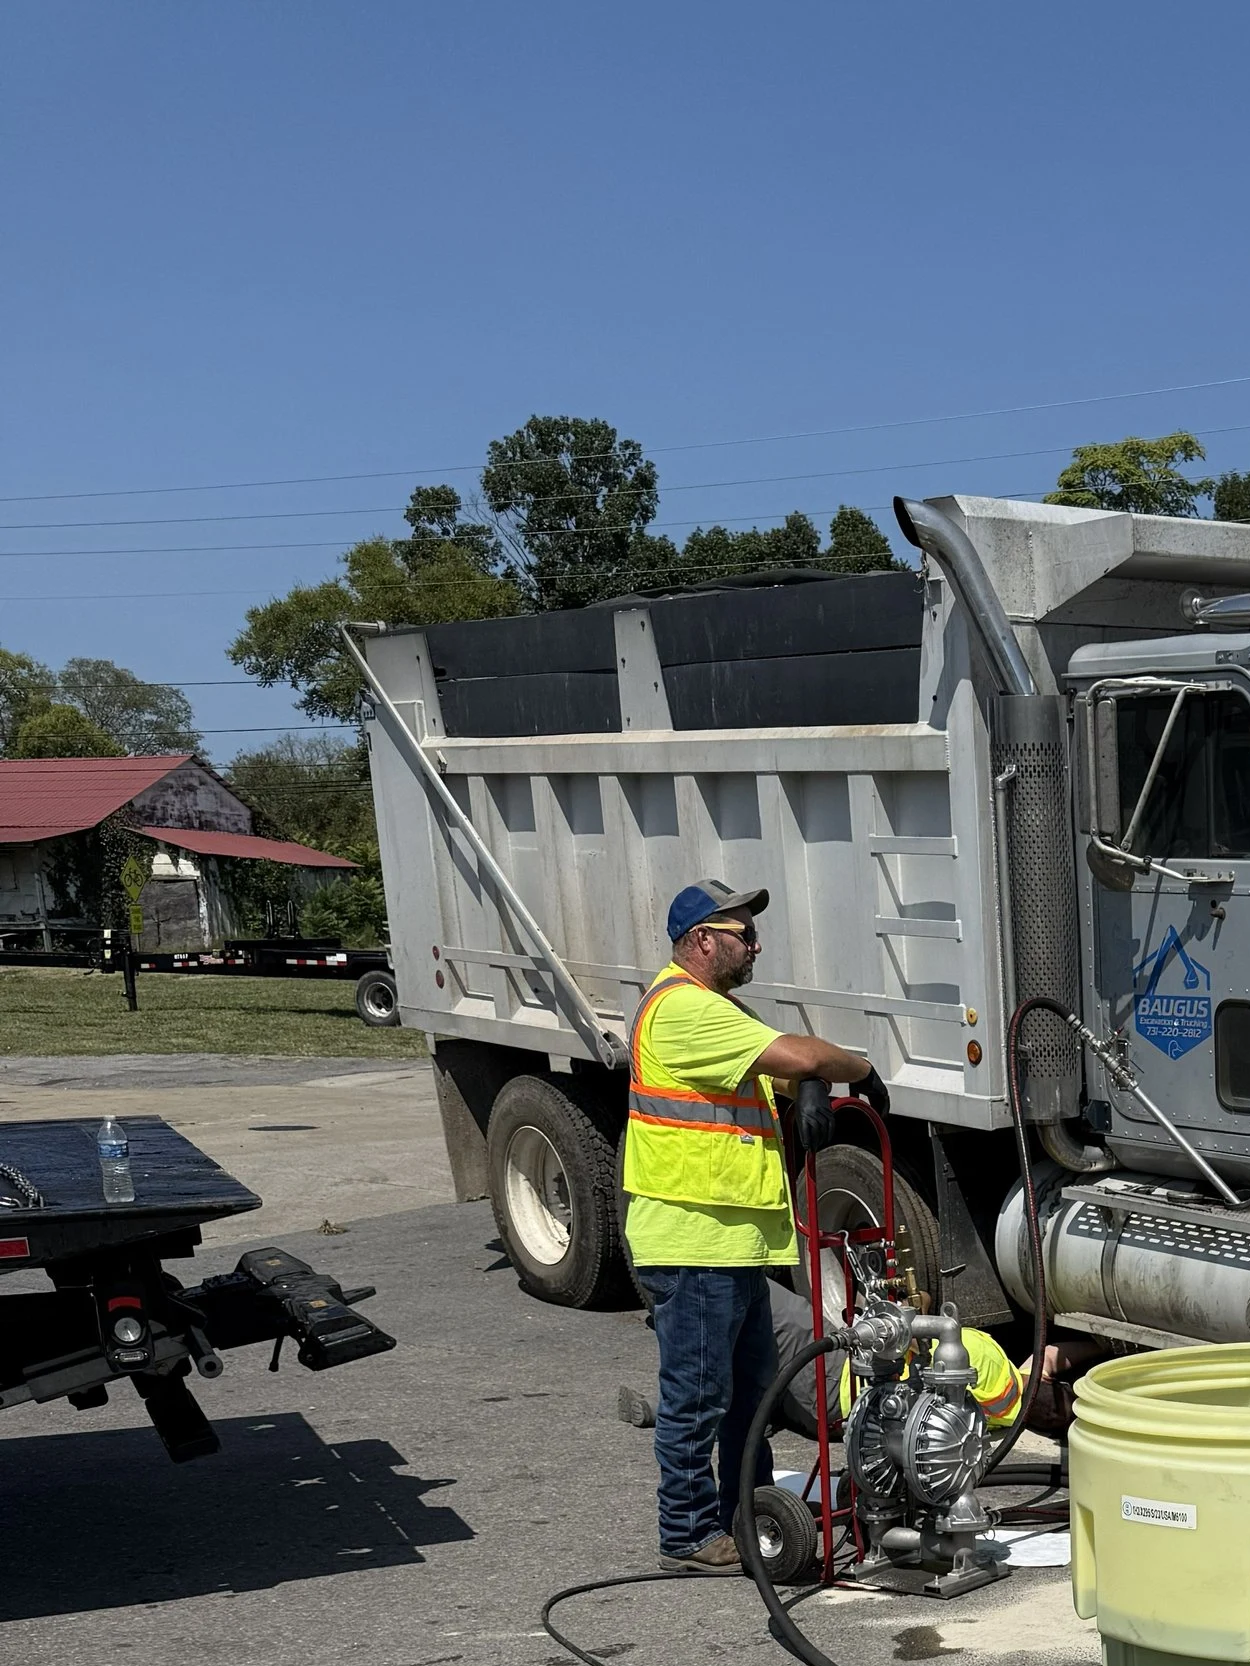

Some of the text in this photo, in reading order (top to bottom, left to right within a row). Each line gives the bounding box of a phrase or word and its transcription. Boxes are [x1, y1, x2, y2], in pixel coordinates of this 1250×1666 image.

[1138, 998, 1209, 1018] BAUGUS
[1140, 1017, 1173, 1026] Excavation
[1181, 1018, 1208, 1029] Trucking
[1147, 1026, 1202, 1038] 731-220-2812
